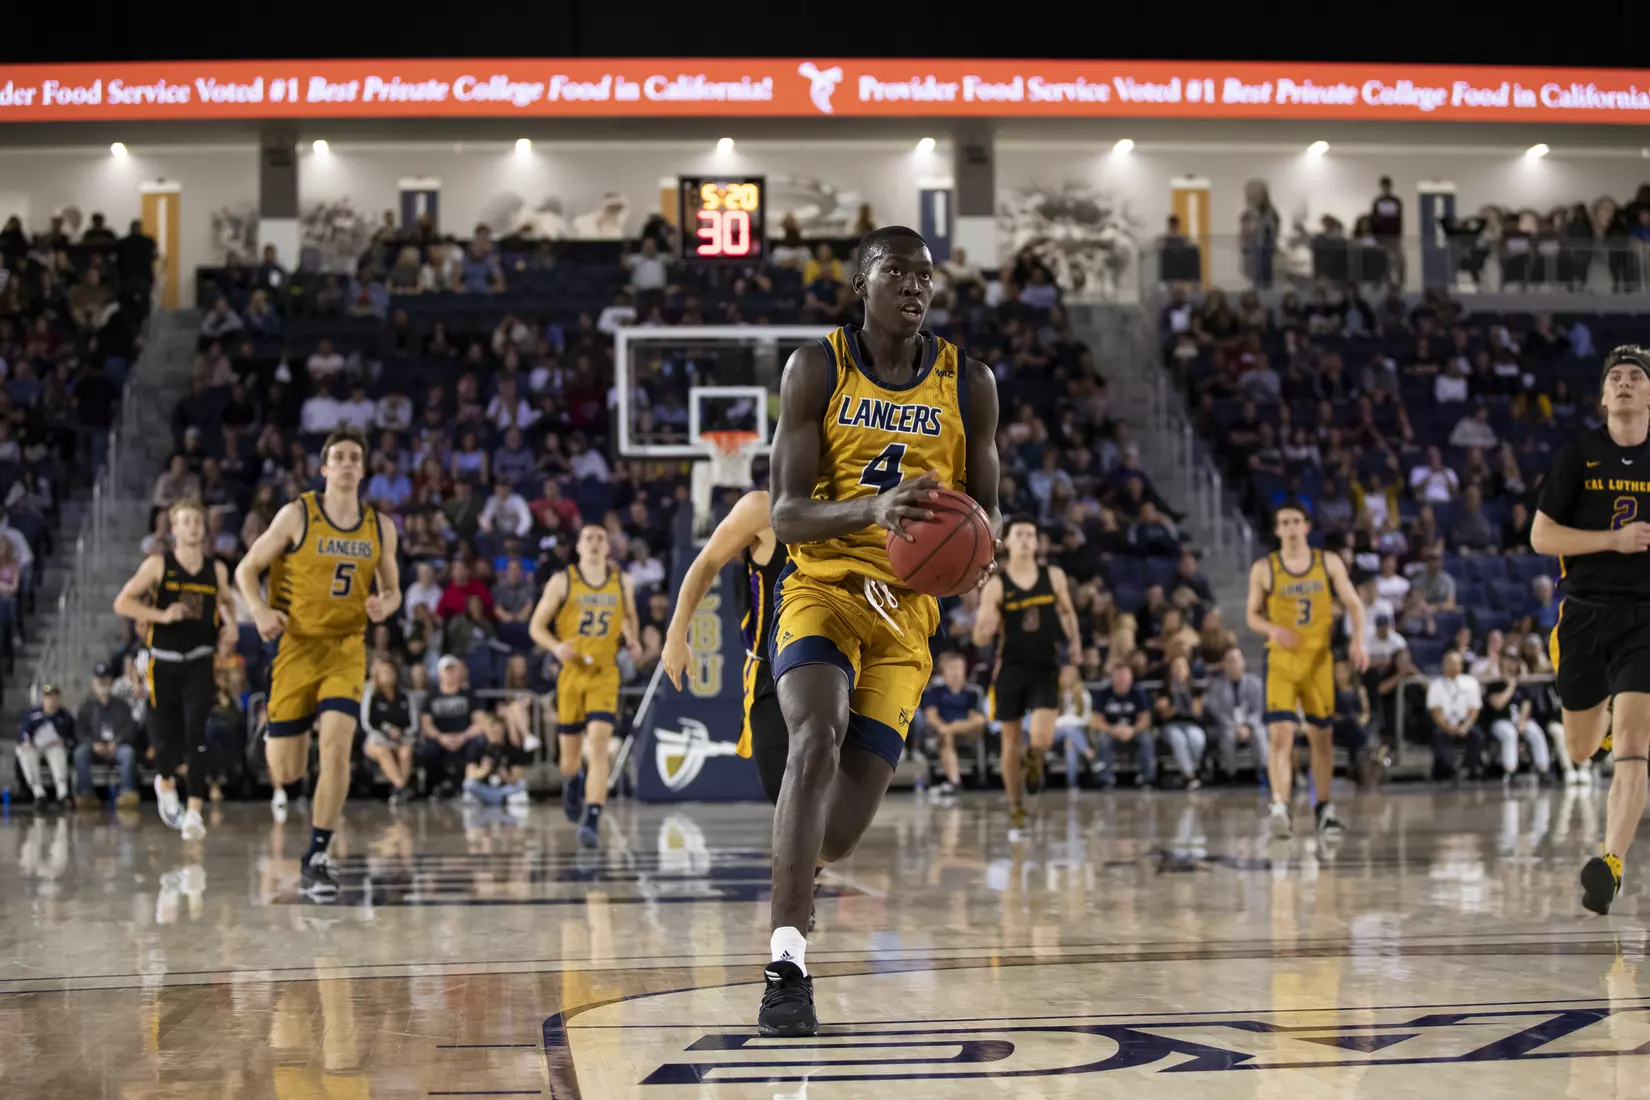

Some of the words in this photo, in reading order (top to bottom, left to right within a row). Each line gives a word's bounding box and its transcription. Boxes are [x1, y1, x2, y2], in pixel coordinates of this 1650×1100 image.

[42, 79, 102, 106] Food
[107, 78, 191, 104] Service
[194, 76, 264, 103] Voted
[269, 77, 299, 103] #1
[306, 76, 360, 103] Best
[362, 75, 449, 102] Private
[452, 74, 544, 107] College
[547, 74, 612, 101] Food
[615, 75, 640, 101] in
[643, 74, 774, 101] California!
[858, 75, 959, 102] Provider
[962, 75, 1024, 102] Food
[1027, 75, 1111, 103] Service
[1113, 76, 1182, 103] Voted
[1185, 78, 1215, 104] #1
[1222, 77, 1273, 104] Best
[1275, 78, 1359, 105] Private
[1361, 79, 1449, 112] College
[1451, 80, 1511, 108] Food
[1513, 82, 1537, 108] in
[1540, 82, 1650, 110] California
[701, 183, 759, 211] 5:20
[697, 210, 750, 256] 30
[838, 394, 942, 437] LANCERS
[858, 442, 908, 497] 4
[1585, 478, 1604, 490] CAL
[1610, 496, 1638, 531] 2
[329, 561, 357, 600] 5
[578, 609, 613, 637] 25
[1295, 598, 1311, 626] 3
